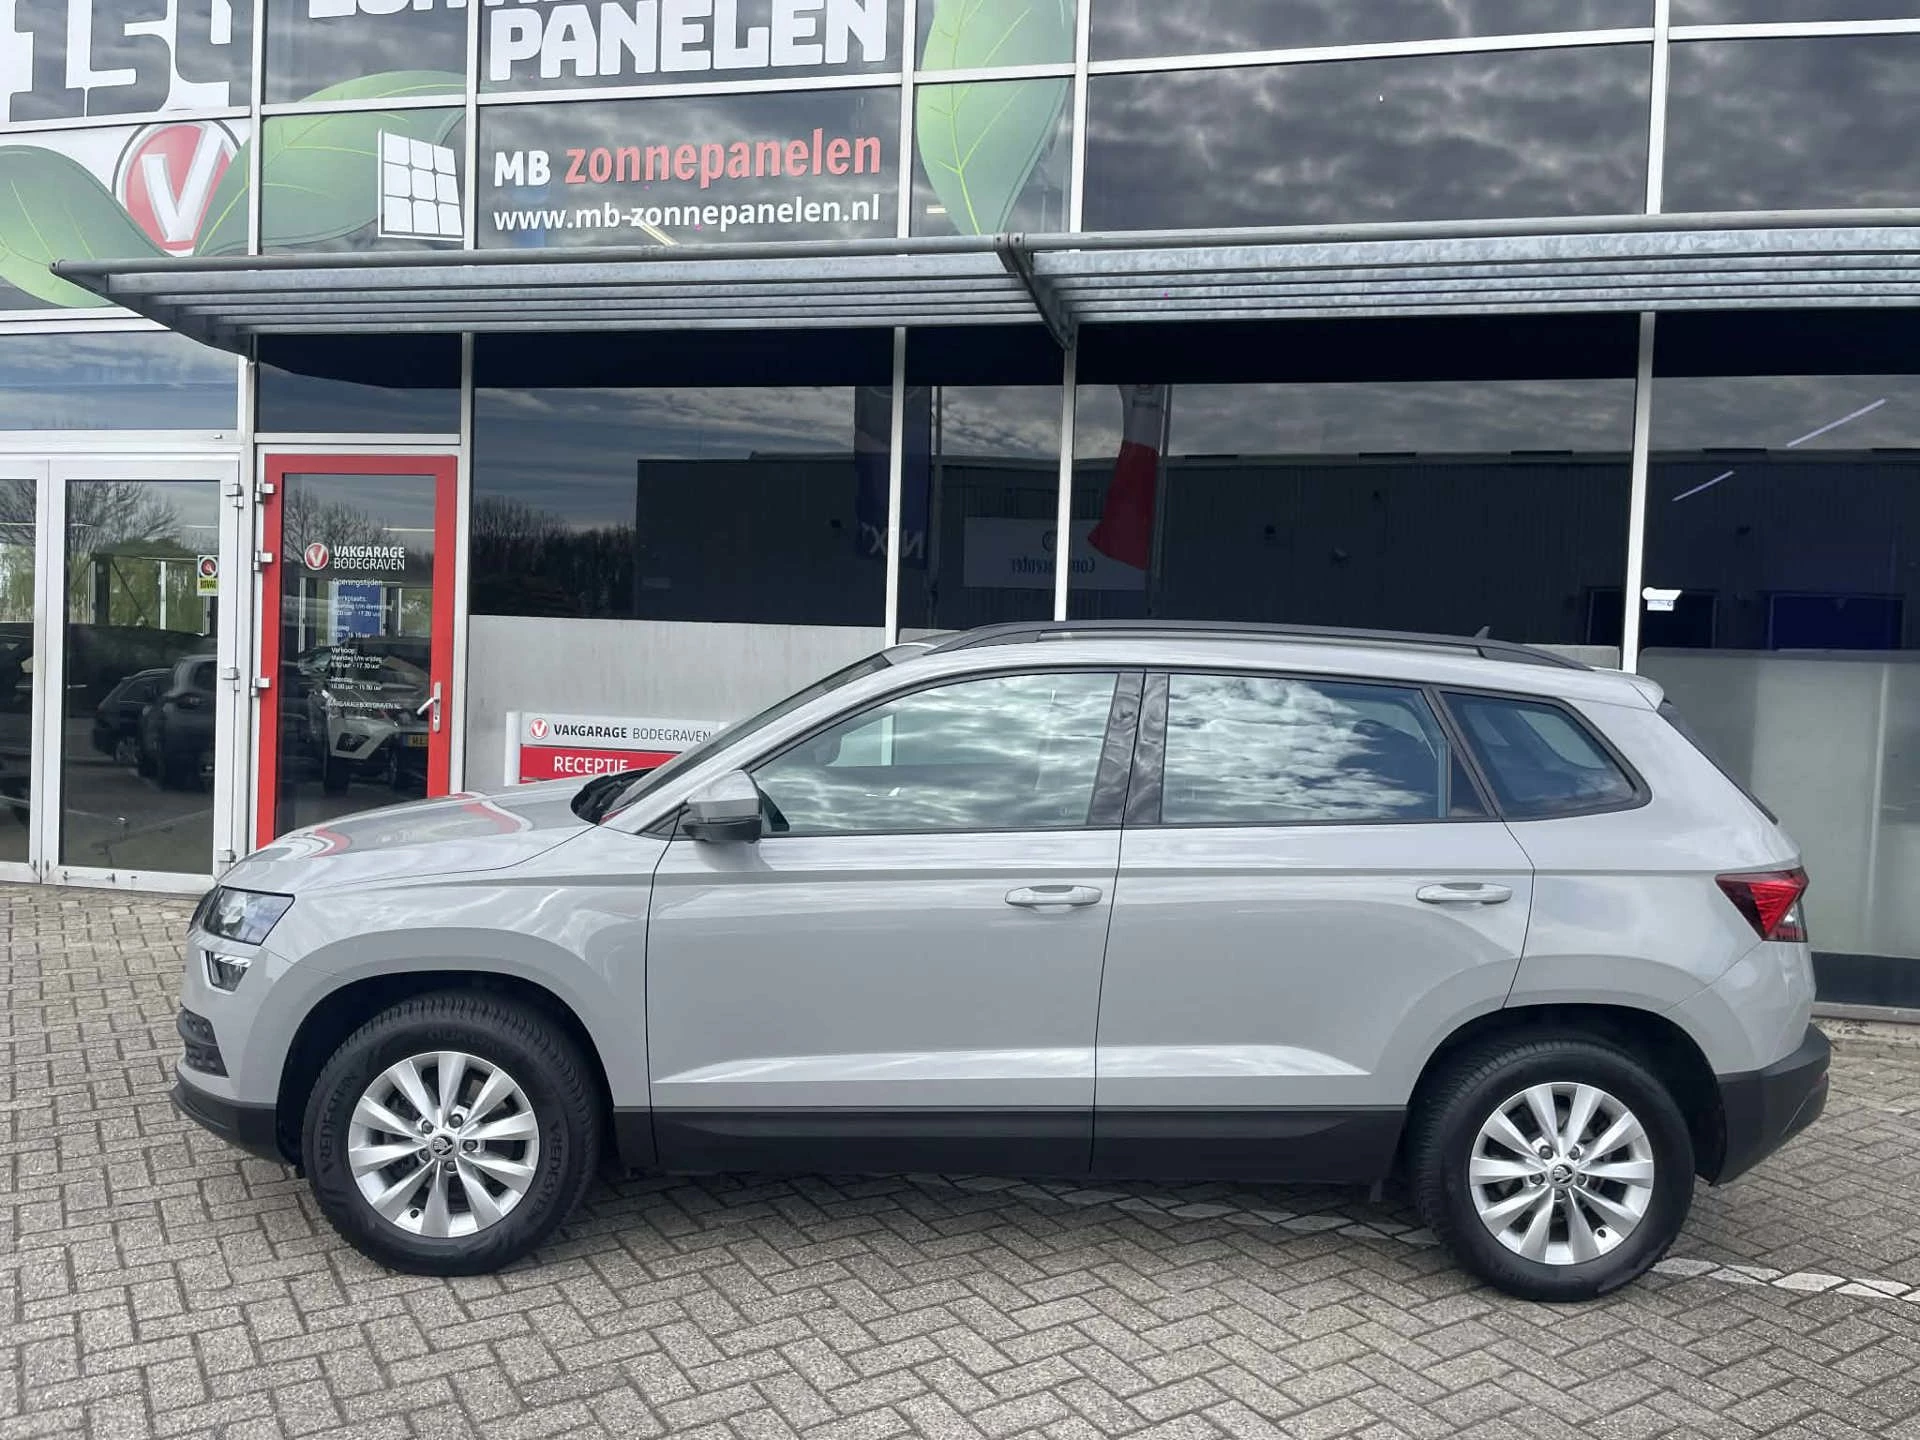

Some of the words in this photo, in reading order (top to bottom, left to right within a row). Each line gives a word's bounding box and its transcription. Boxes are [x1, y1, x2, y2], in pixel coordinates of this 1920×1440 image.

[490, 0, 887, 81] PANELEN
[494, 150, 551, 187] MB
[565, 127, 881, 189] zonnepanelen
[494, 194, 880, 232] www.mb-zonnepanelen.nl
[334, 545, 405, 558] VAKGARAGE
[334, 558, 405, 571] BODEGRAVEN
[554, 724, 627, 739] VAKGARAGE
[633, 727, 711, 743] BODEGRAVEN
